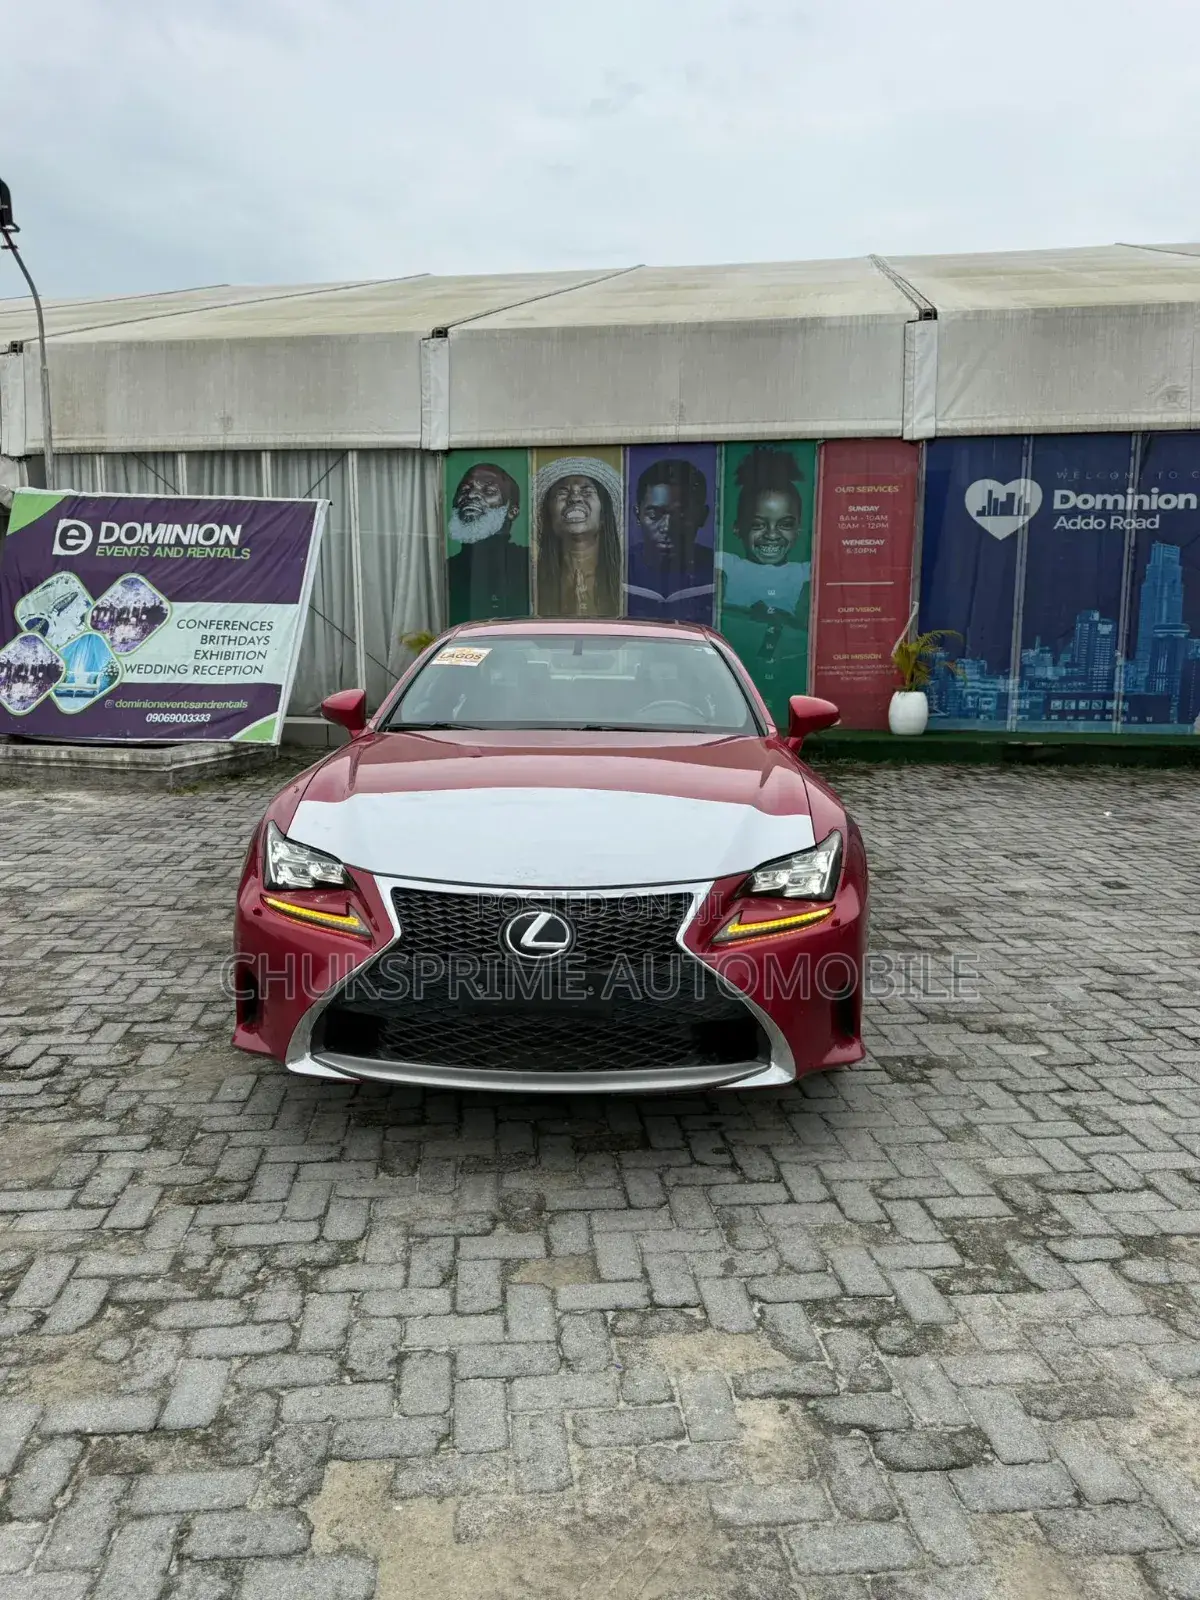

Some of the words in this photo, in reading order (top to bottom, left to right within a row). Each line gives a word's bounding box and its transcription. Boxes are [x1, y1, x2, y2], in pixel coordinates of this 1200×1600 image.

[835, 486, 855, 494] OUR
[856, 485, 899, 493] SERVICES
[1053, 487, 1198, 510] Dominion
[1053, 515, 1107, 530] Addo
[1109, 514, 1160, 530] Road
[98, 521, 242, 546] DOMINION
[95, 545, 150, 557] EVENTS
[152, 547, 184, 558] AND
[186, 547, 251, 560] RENTALS
[176, 619, 274, 631] CONFERENCES
[200, 635, 270, 646] BRITHDAYS
[193, 650, 267, 661] EXHIBITION
[125, 664, 188, 675] WEDDING
[192, 665, 264, 676] RECEPTION
